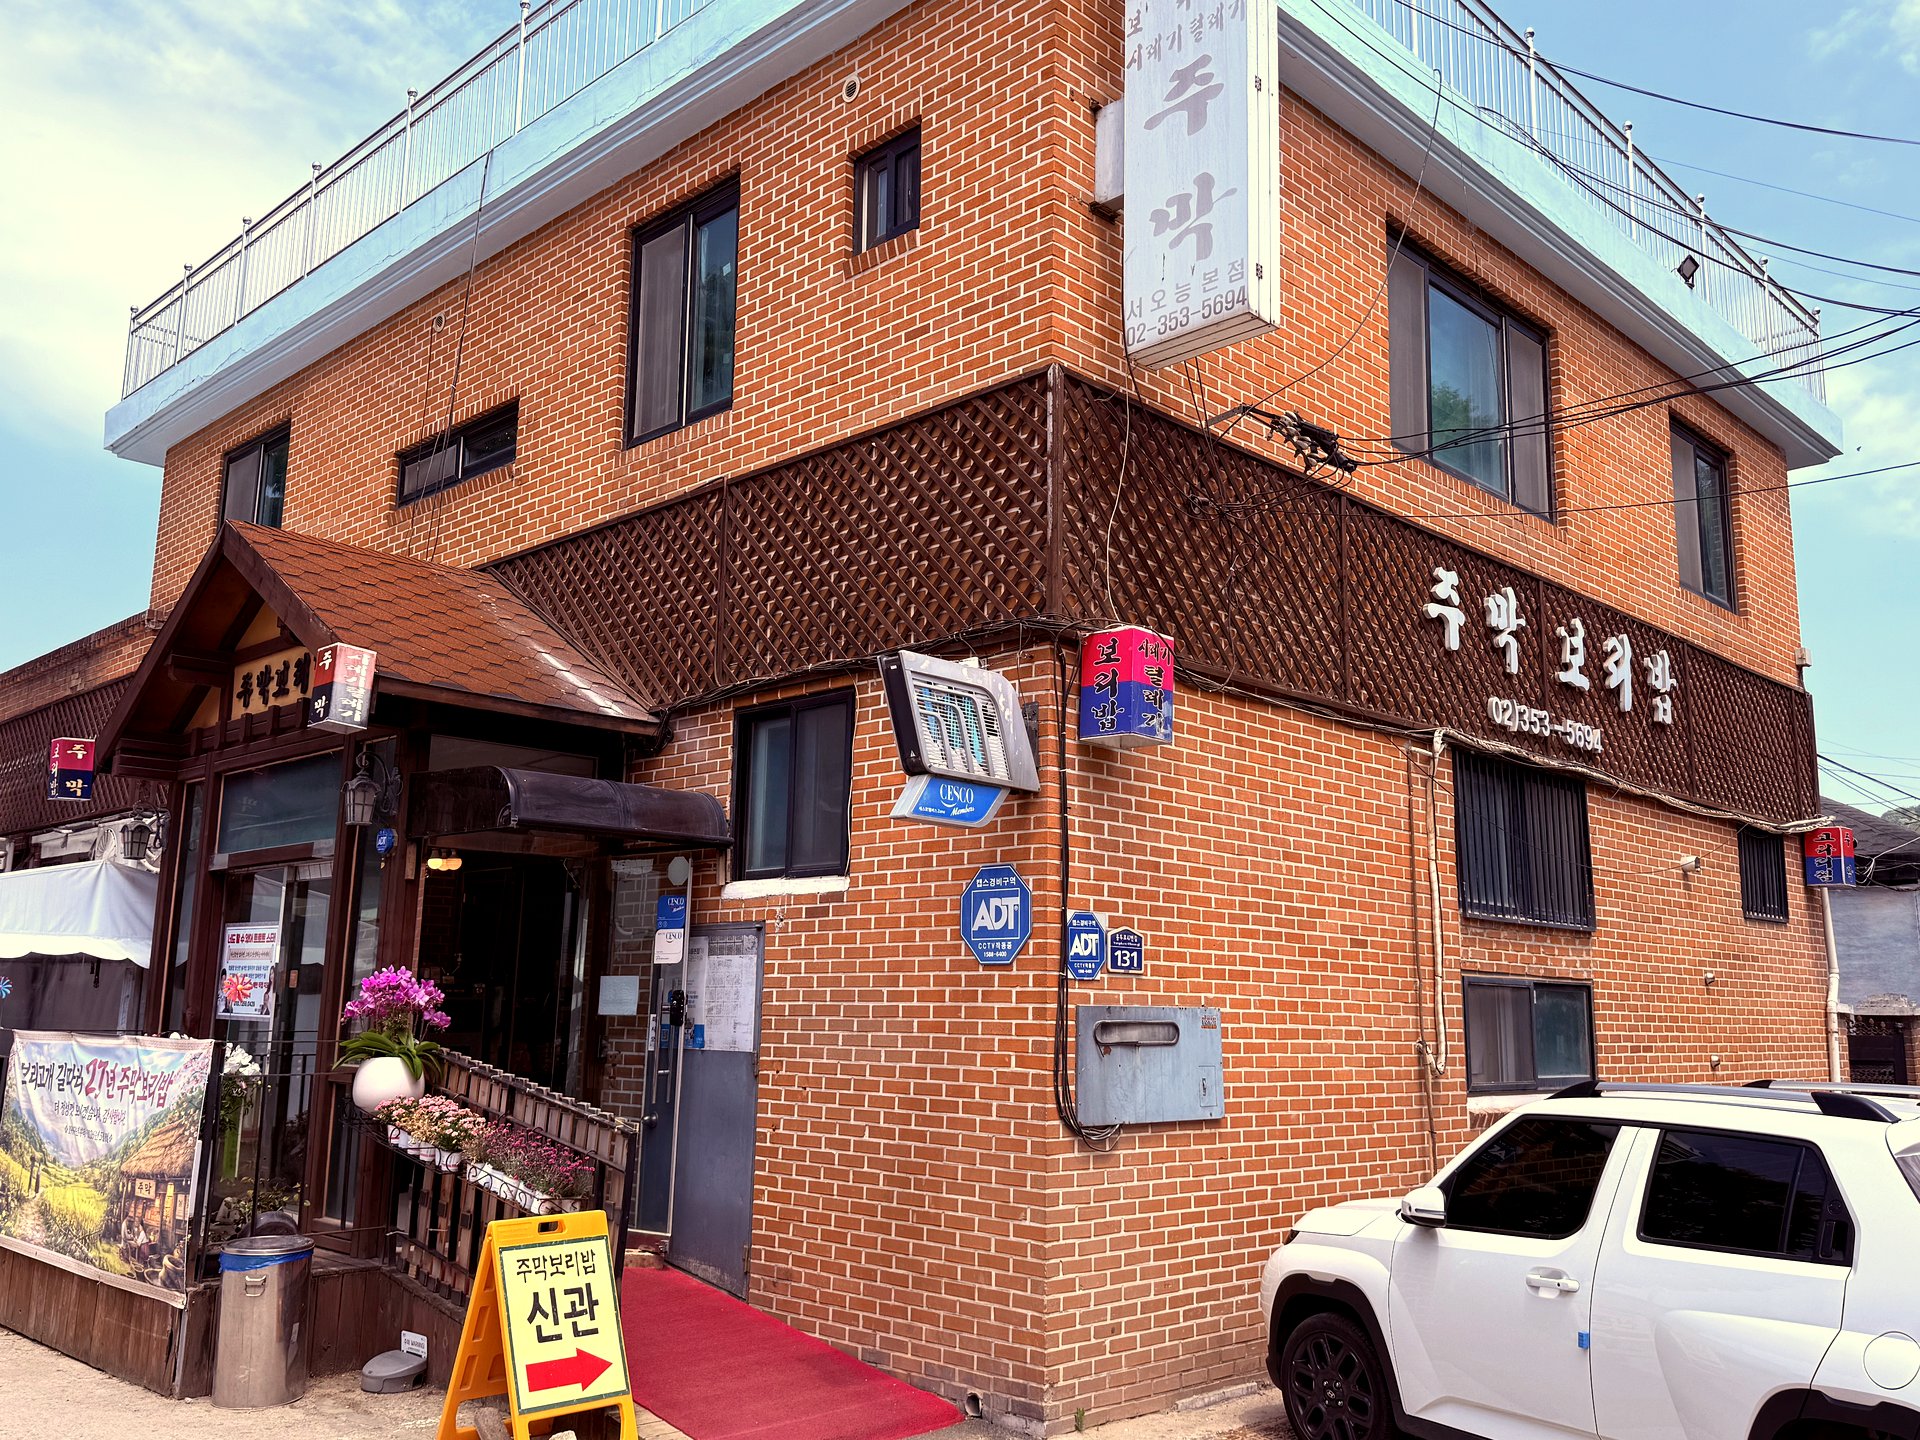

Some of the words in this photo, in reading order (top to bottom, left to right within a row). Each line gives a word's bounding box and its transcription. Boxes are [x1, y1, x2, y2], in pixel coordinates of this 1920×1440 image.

[1143, 54, 1238, 262] 주막
[1126, 285, 1248, 347] 02-353-5694
[236, 652, 316, 708] 주막보리
[314, 650, 333, 718] 주막
[1092, 637, 1125, 731] 보리밥
[66, 744, 88, 797] 주막
[940, 783, 975, 805] CESCO
[971, 896, 1020, 931] ADT
[1069, 933, 1099, 957] ADT
[1114, 950, 1138, 968] 131
[516, 1249, 596, 1283] 주막보리밥
[527, 1283, 600, 1343] 신관
